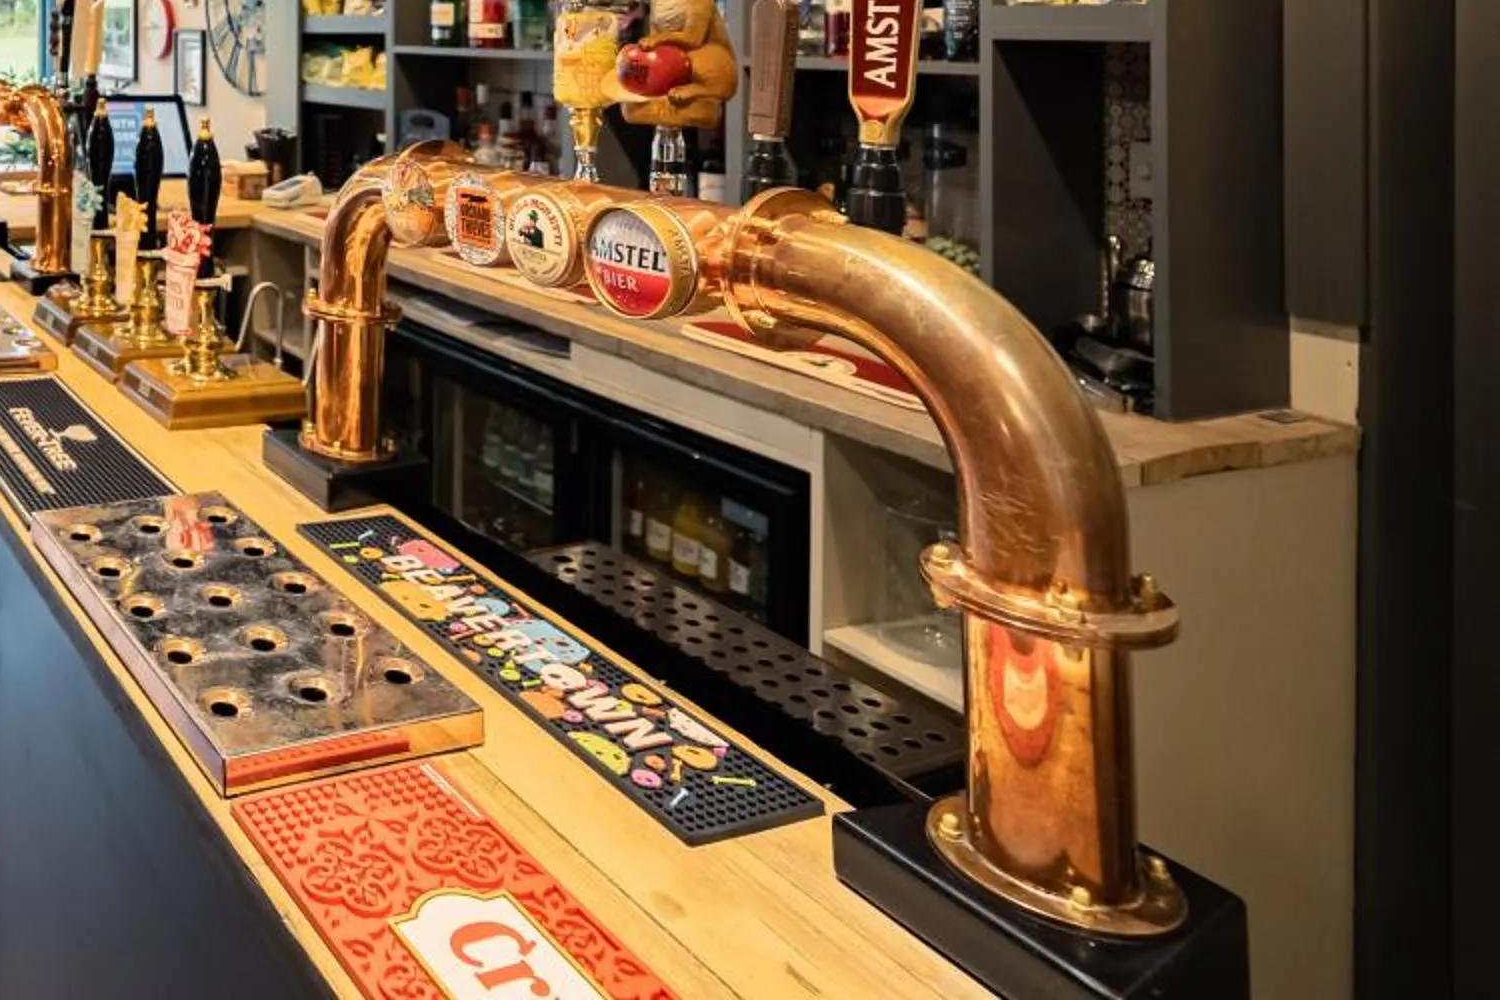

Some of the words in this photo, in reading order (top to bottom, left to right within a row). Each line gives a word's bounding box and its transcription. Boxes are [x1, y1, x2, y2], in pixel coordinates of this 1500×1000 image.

[590, 235, 667, 273] AMSTEL
[602, 268, 640, 293] BIER
[381, 552, 676, 752] BEAVERTOWN
[450, 921, 562, 1000] Cr
